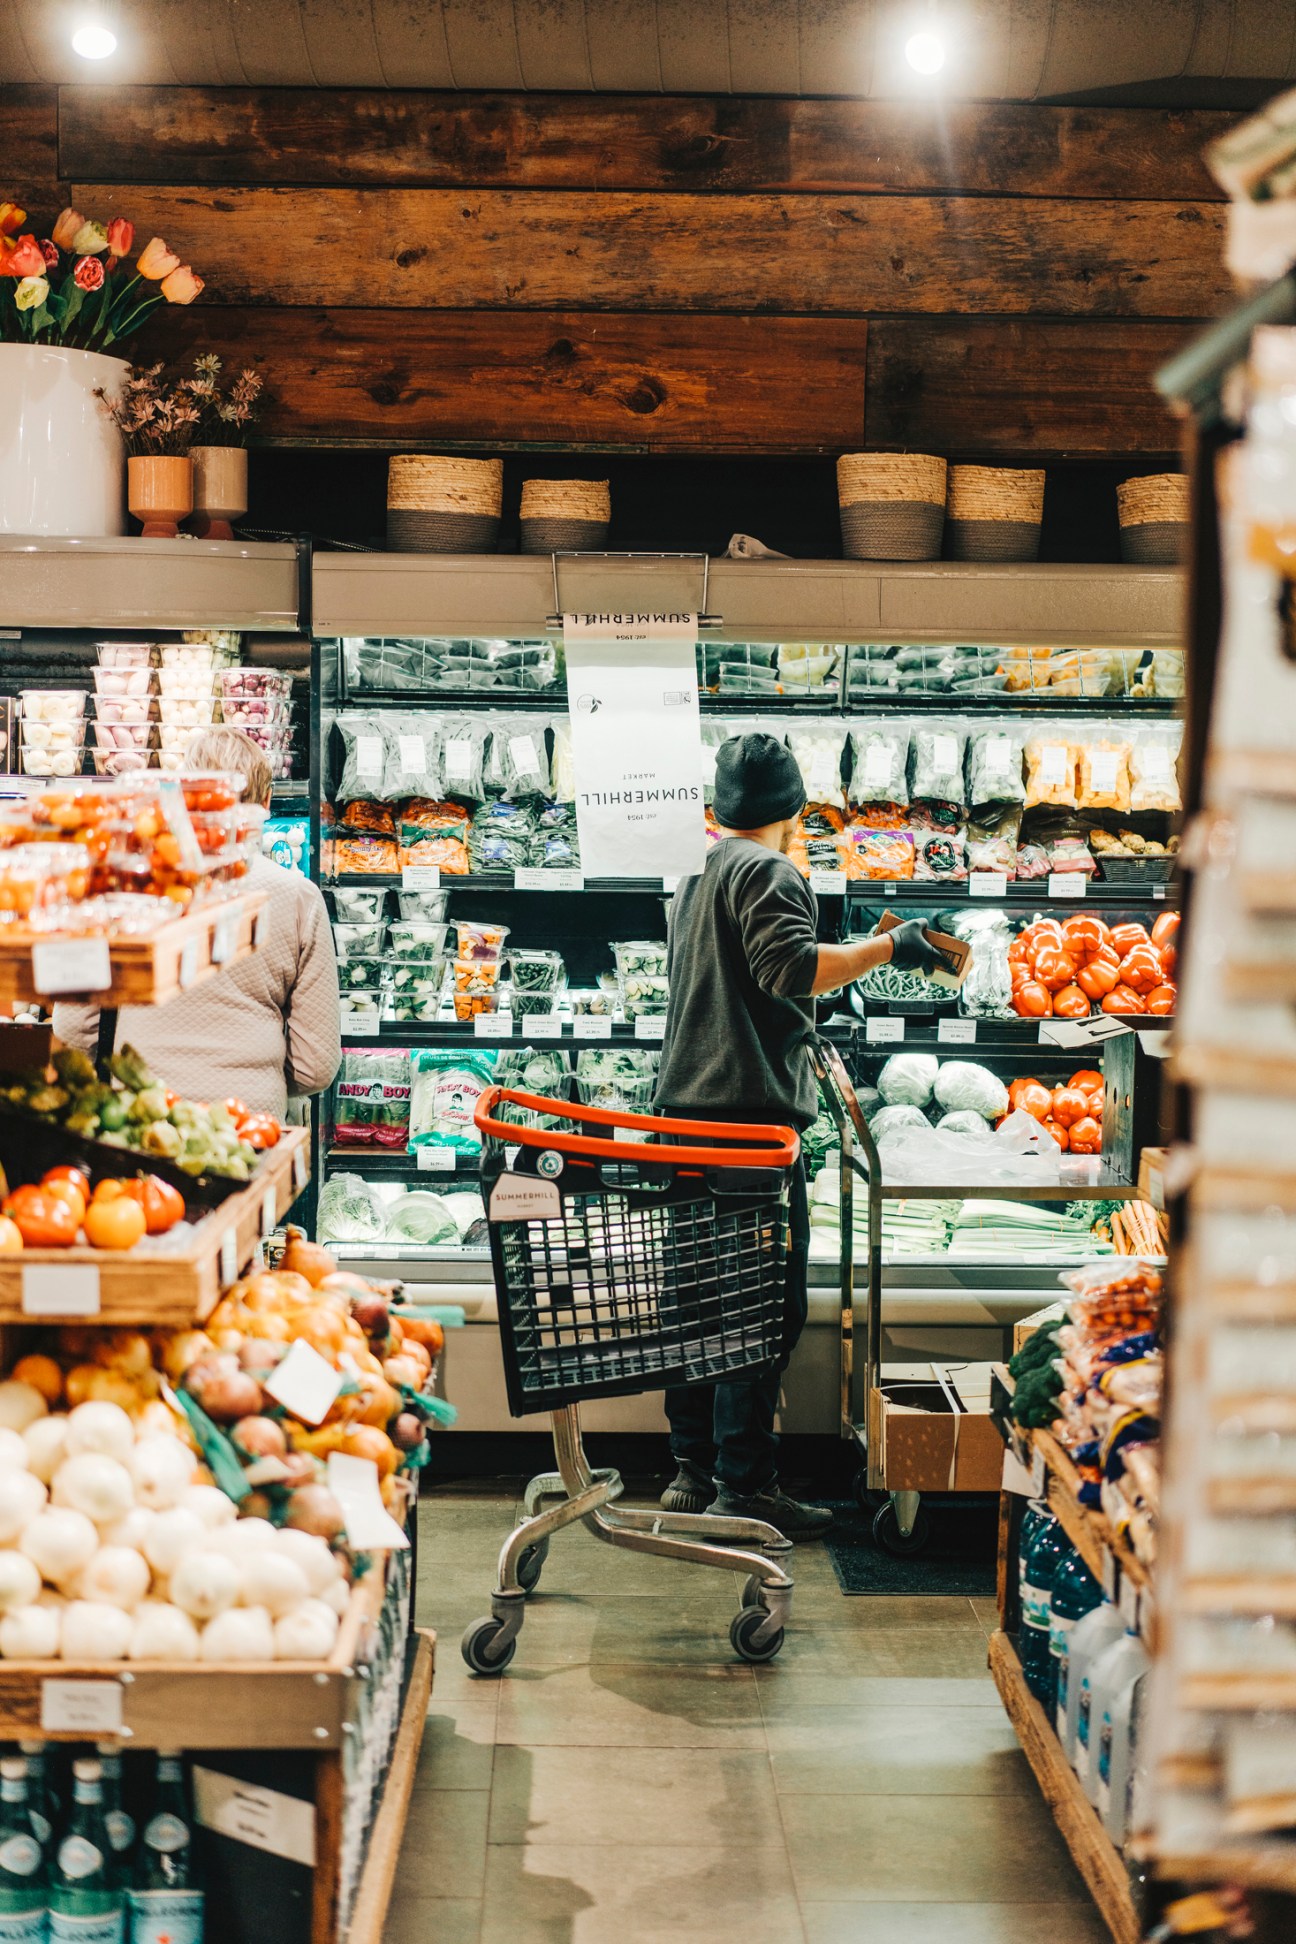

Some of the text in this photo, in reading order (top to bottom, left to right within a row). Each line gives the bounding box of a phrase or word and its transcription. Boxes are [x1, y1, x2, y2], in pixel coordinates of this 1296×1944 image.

[569, 612, 691, 625] SUMMERHILL
[615, 633, 633, 641] 1954
[622, 772, 655, 780] MARKET
[580, 786, 699, 807] SUMMERHILL
[626, 813, 644, 822] 1954
[338, 1082, 411, 1099] ANDY BOY
[462, 1084, 482, 1098] BOY
[495, 1191, 556, 1202] SUMMERHILL
